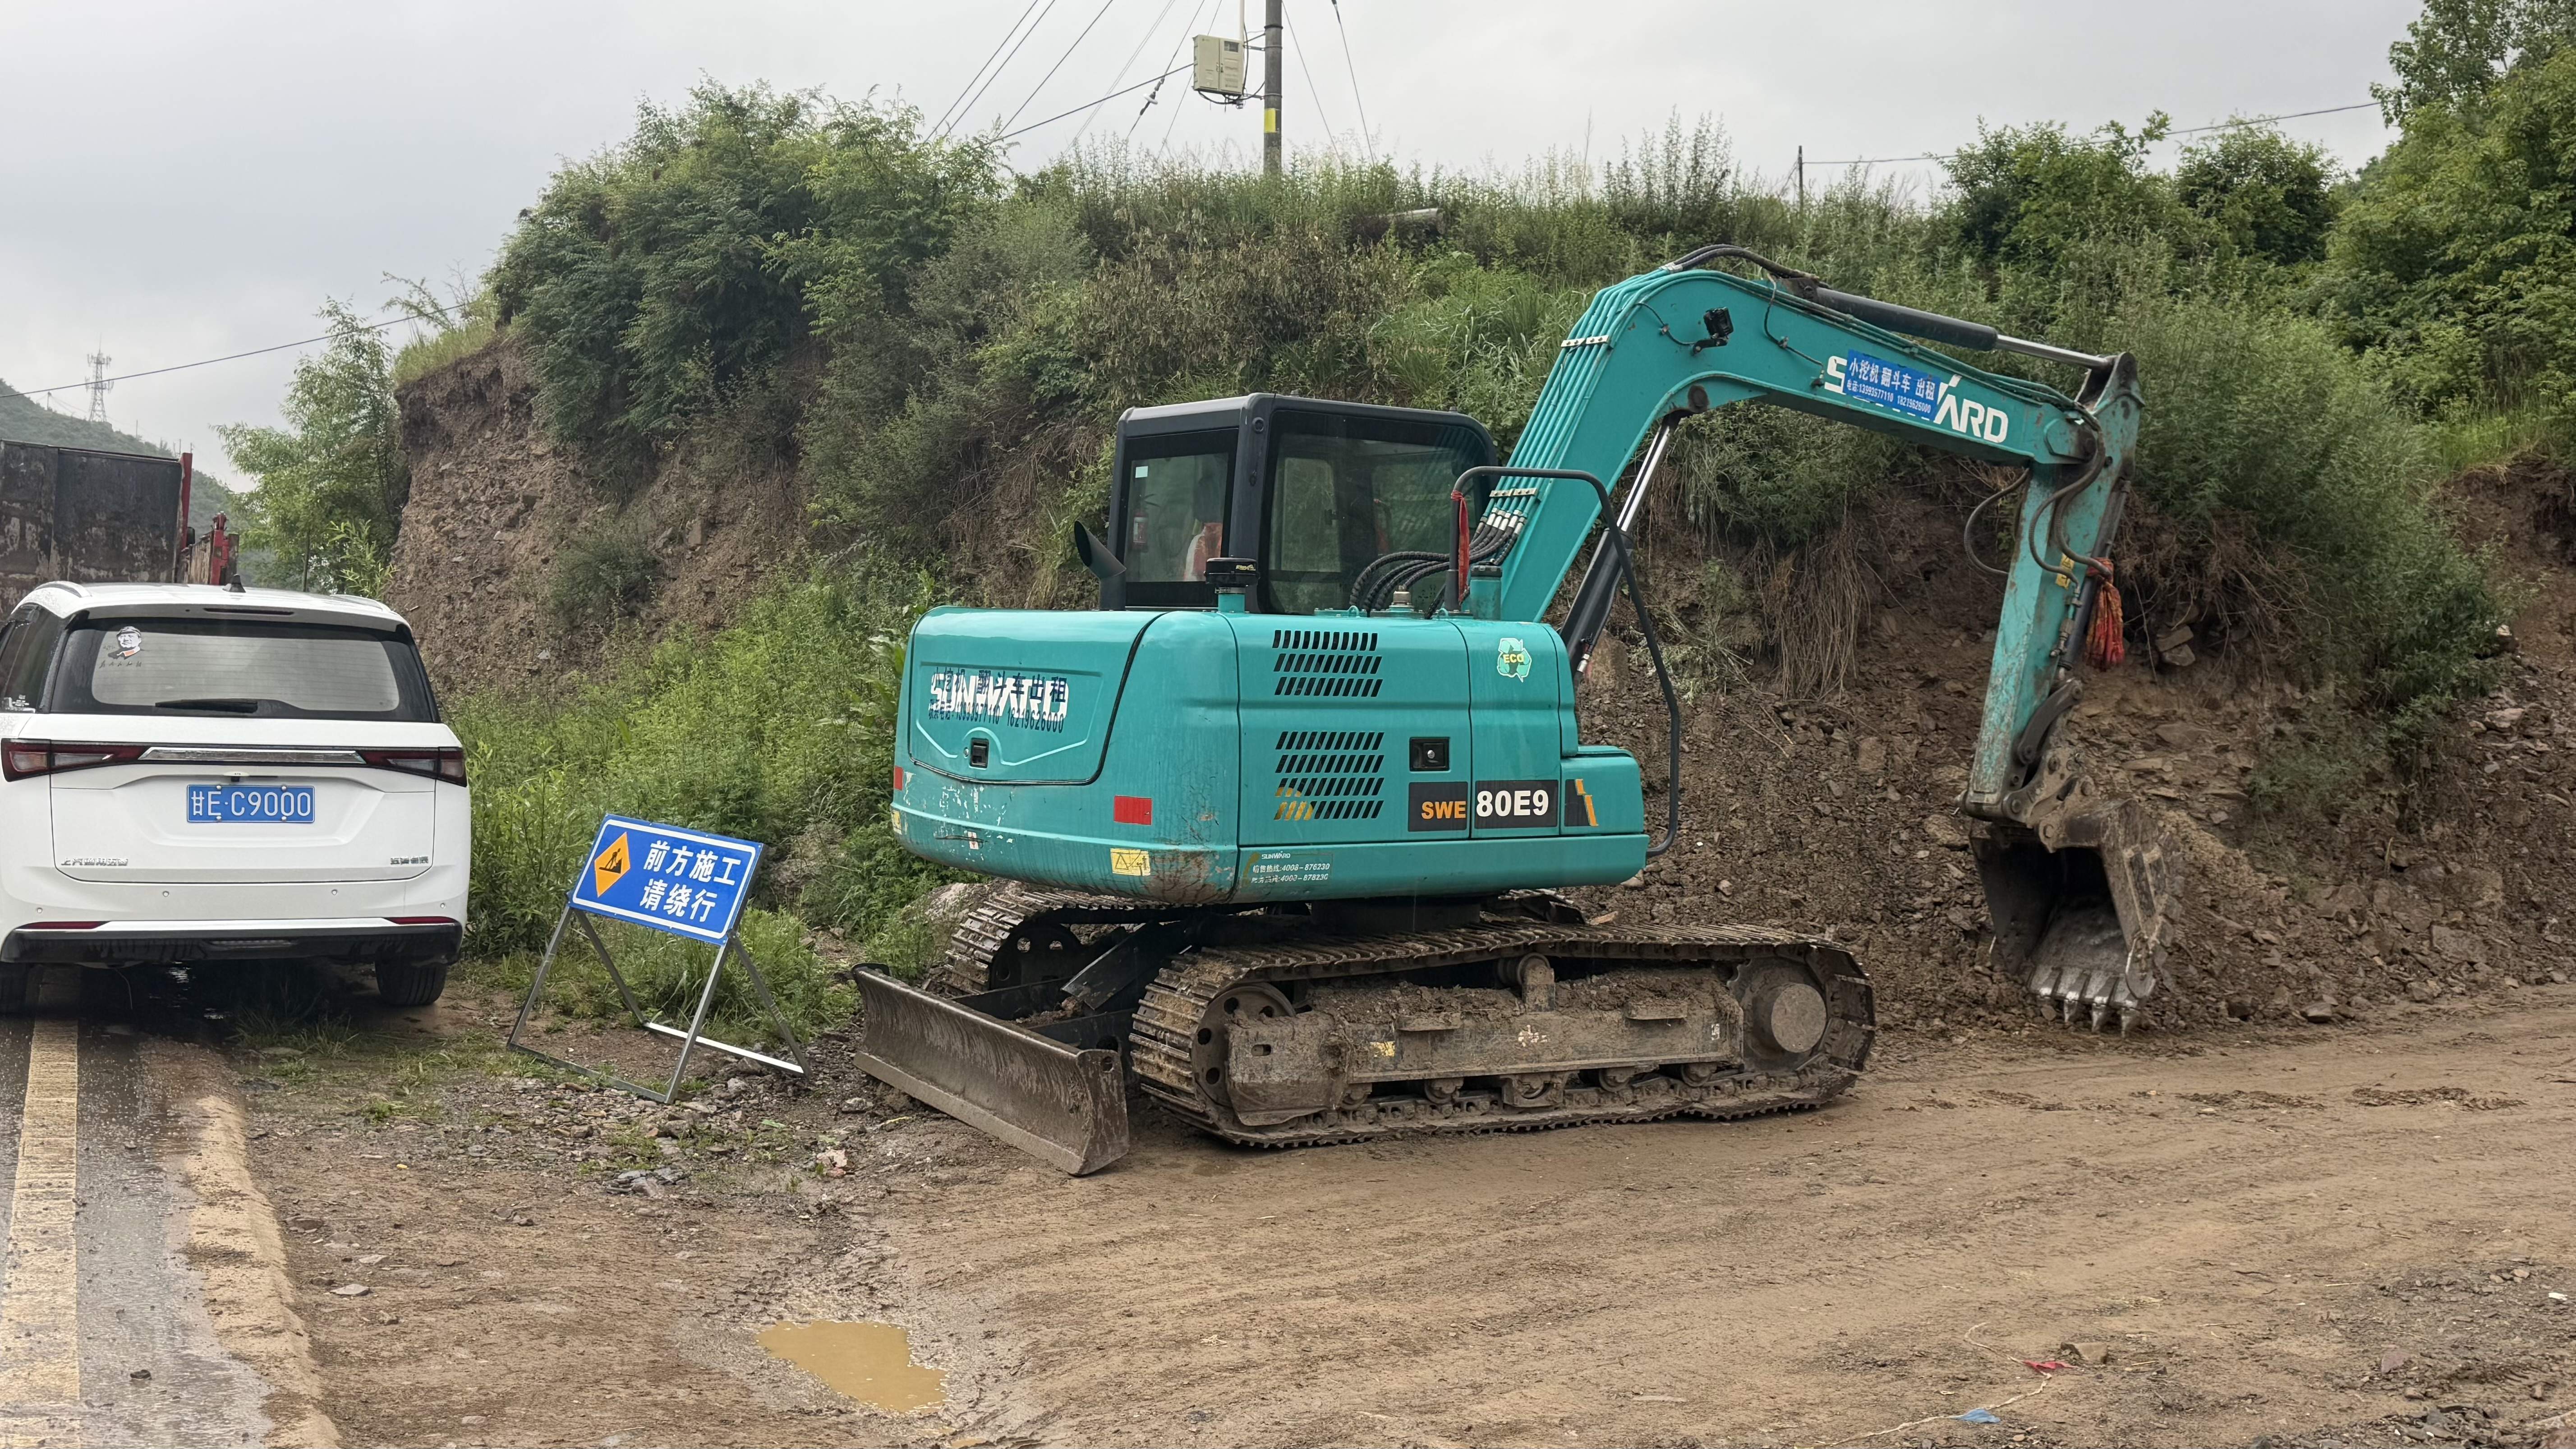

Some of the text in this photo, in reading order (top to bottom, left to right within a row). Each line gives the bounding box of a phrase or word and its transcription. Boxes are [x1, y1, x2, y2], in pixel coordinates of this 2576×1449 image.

[1849, 358, 1936, 400] 小挖机 翻斗车 出租
[1824, 356, 2009, 443] SARD
[1503, 653, 1524, 663] ECO
[932, 667, 966, 694] 小挖机
[1007, 707, 1064, 734] 18219626000
[1421, 790, 1549, 819] SWE 80E9
[643, 840, 741, 886] 前方施工
[639, 878, 718, 922] 请绕行
